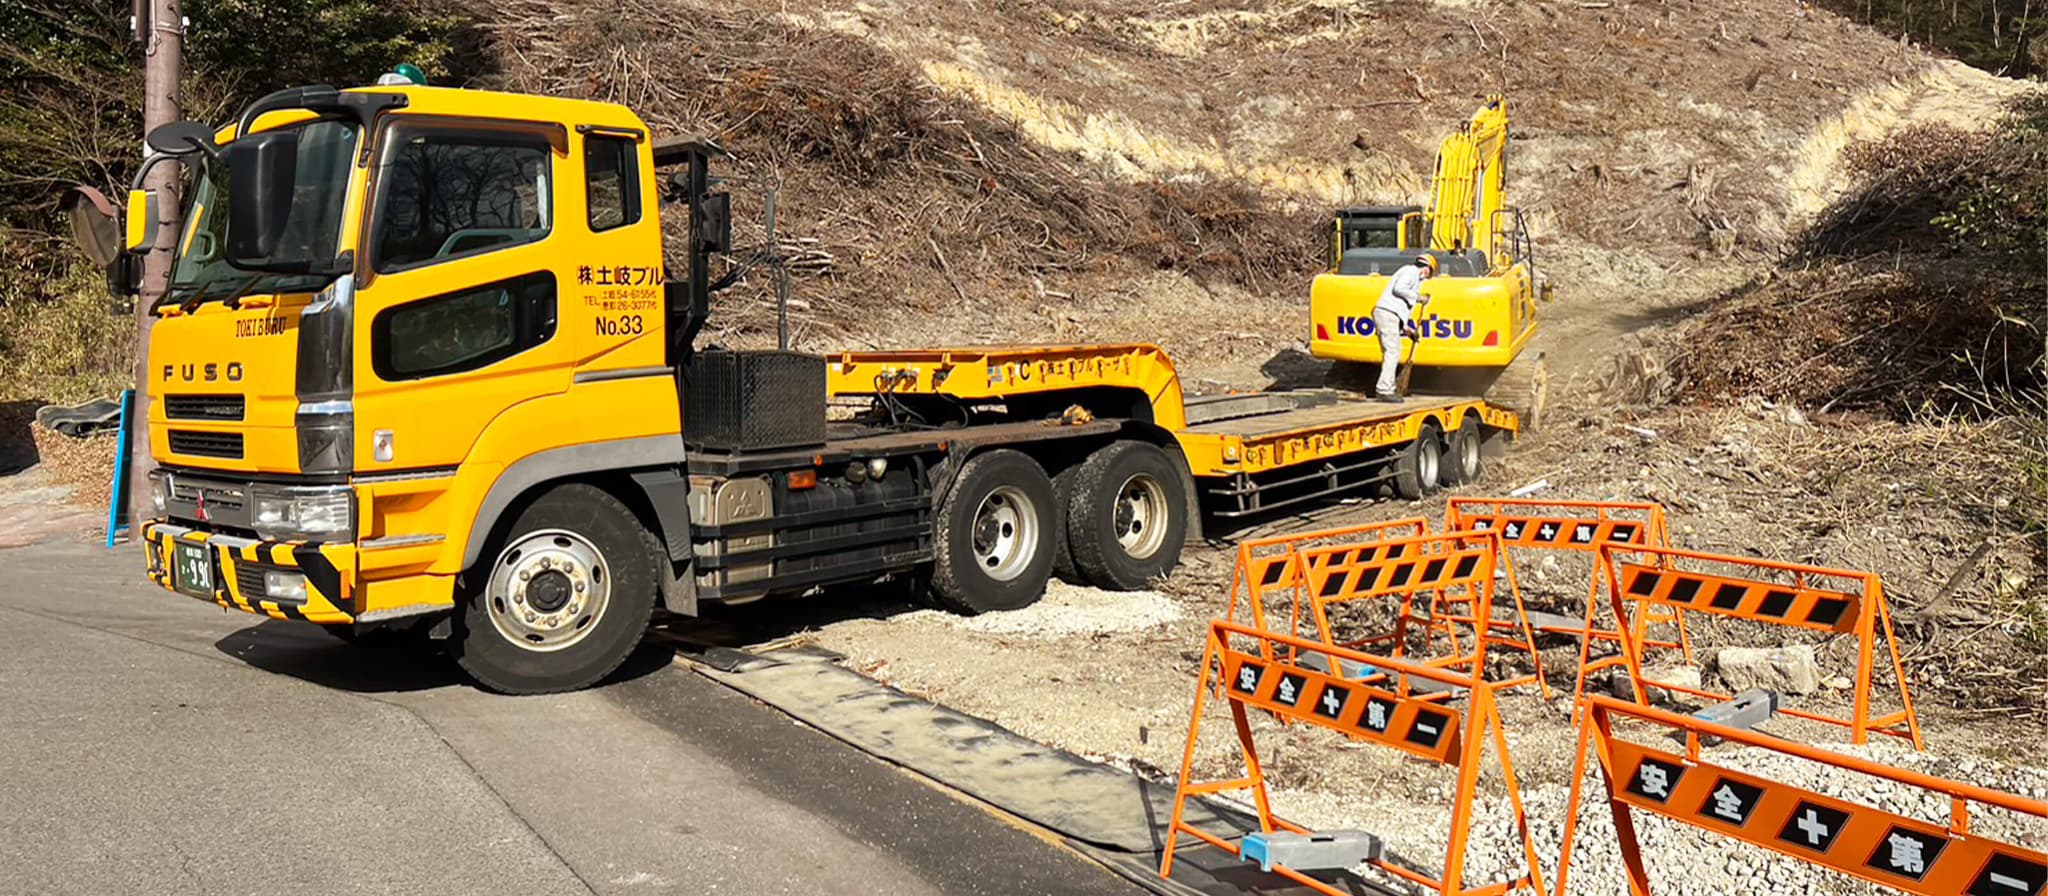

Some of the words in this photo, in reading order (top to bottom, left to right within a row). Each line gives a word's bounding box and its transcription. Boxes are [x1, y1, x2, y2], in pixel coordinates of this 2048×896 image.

[596, 315, 643, 336] No.33
[1337, 313, 1472, 338] KOTSU
[163, 362, 243, 382] FUSO
